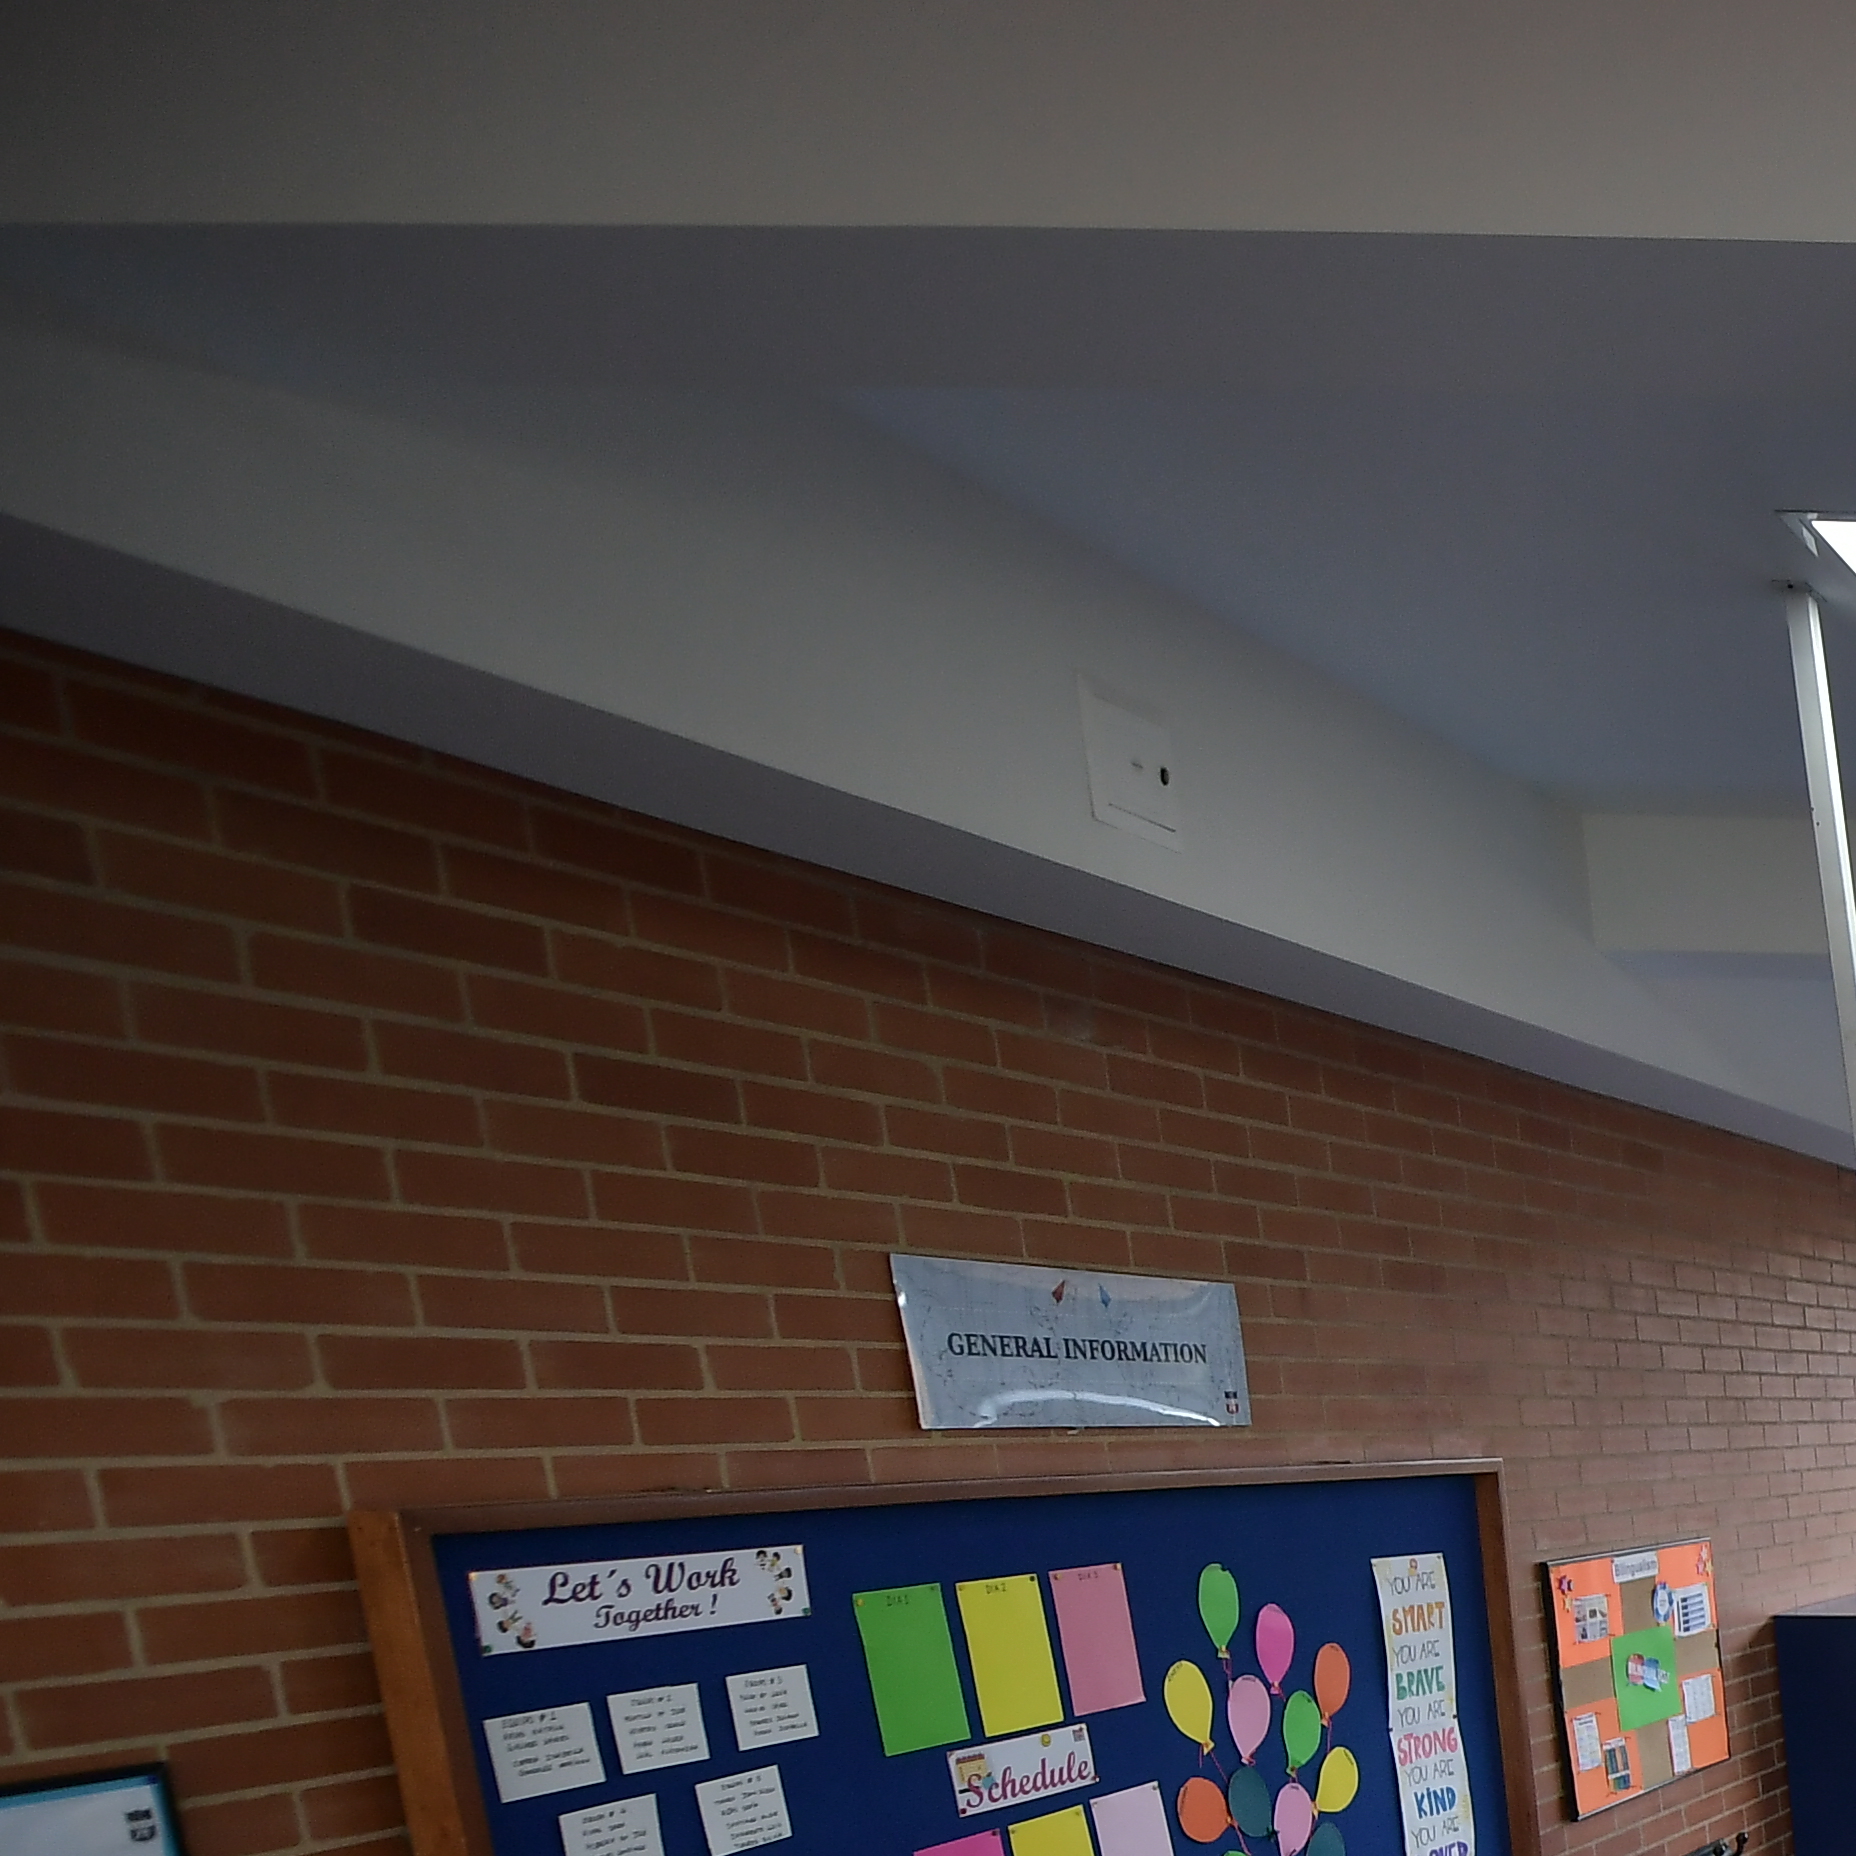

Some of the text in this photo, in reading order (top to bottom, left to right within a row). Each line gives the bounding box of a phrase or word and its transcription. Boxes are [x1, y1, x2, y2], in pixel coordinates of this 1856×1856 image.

[947, 1332, 1207, 1365] GENERAL INFORMATION
[542, 1556, 740, 1606] Let's Work
[1387, 1571, 1436, 1596] YOU ARE
[1614, 1558, 1657, 1578] Bilingualism
[1392, 1601, 1445, 1636] SMART
[1392, 1640, 1440, 1667] YOU ARE
[1396, 1665, 1446, 1700] BRAVE
[1397, 1700, 1445, 1728] YOU ARE
[1397, 1727, 1458, 1766] STRONG
[965, 1751, 1092, 1808] Schedule
[1405, 1759, 1454, 1787] YOU ARE
[1414, 1786, 1457, 1820] KIND
[1411, 1816, 1459, 1848] YOU ARE
